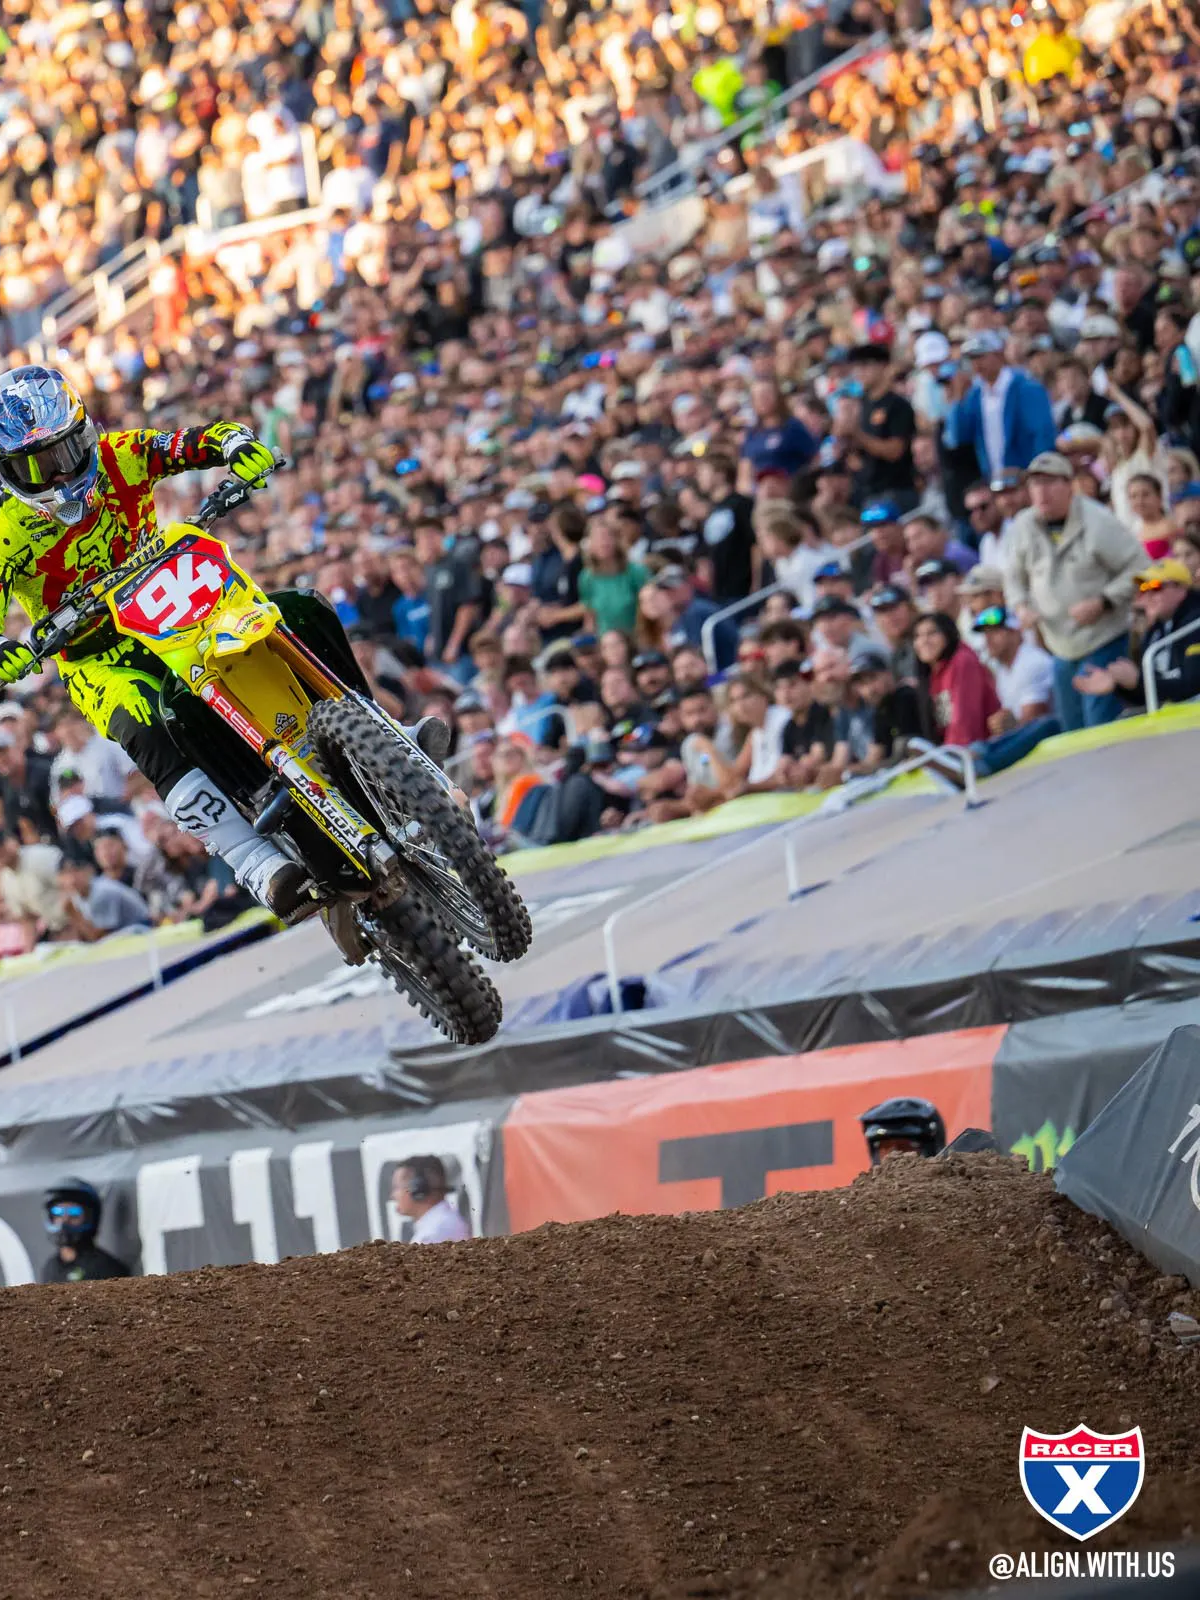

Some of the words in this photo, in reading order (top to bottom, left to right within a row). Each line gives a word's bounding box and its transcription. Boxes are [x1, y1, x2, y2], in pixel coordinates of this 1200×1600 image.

[224, 489, 244, 508] ASV
[135, 553, 224, 634] 94
[294, 774, 360, 838] DUNLOP
